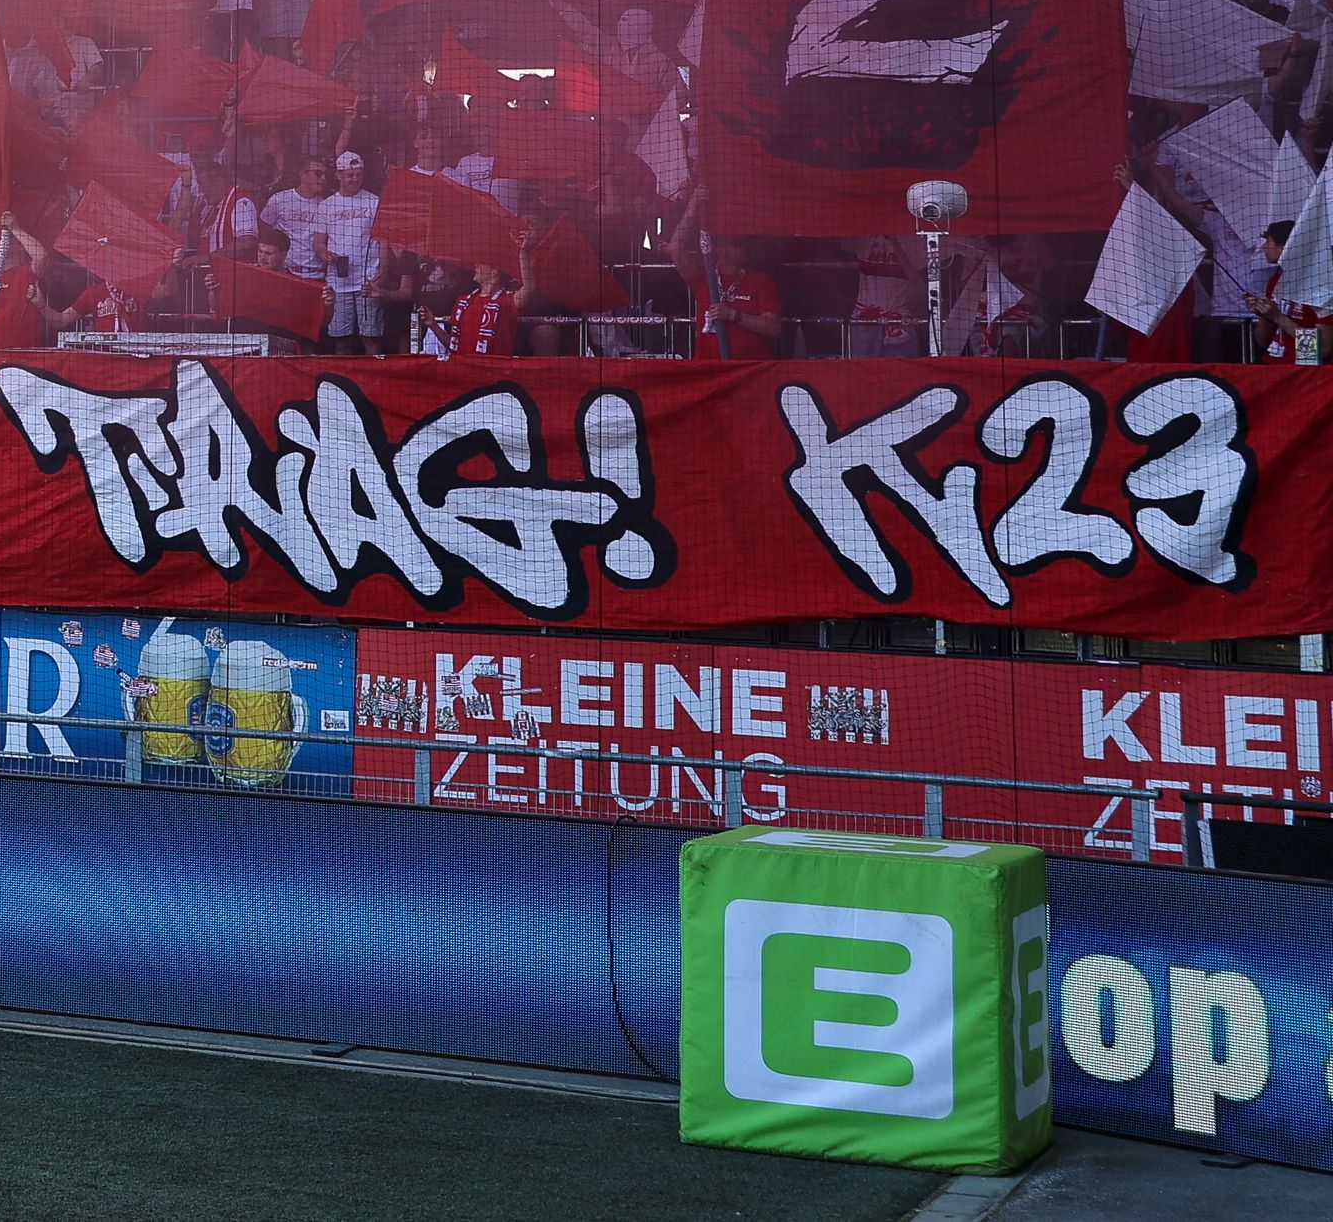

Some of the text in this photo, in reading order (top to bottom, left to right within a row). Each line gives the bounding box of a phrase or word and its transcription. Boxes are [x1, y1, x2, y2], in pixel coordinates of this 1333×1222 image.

[775, 369, 1260, 610] K23
[435, 653, 788, 738] KLEINE
[432, 733, 788, 822] ZEITUNG
